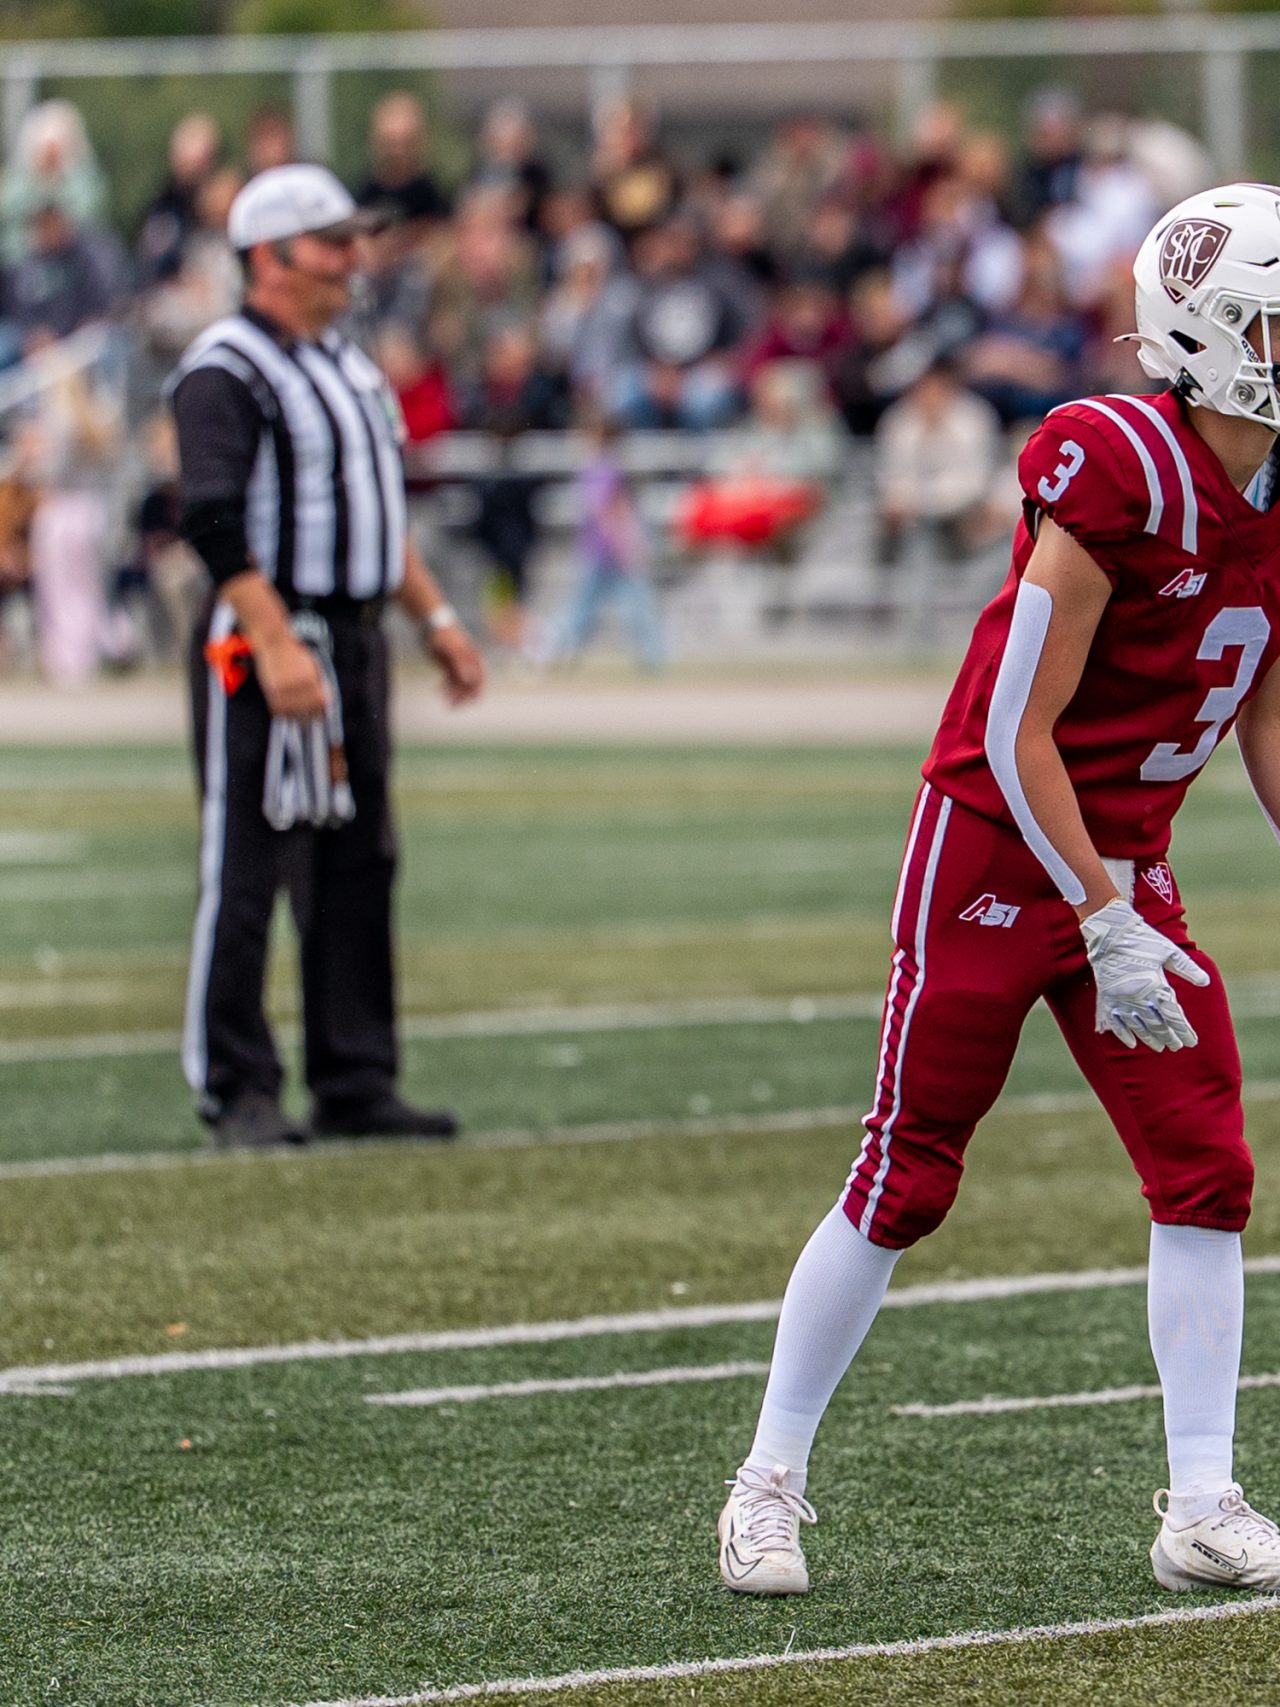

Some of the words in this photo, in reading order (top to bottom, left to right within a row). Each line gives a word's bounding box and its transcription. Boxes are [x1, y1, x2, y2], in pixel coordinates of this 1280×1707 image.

[1037, 440, 1085, 502] 3
[1140, 606, 1271, 781] 3
[959, 893, 1021, 928] A51
